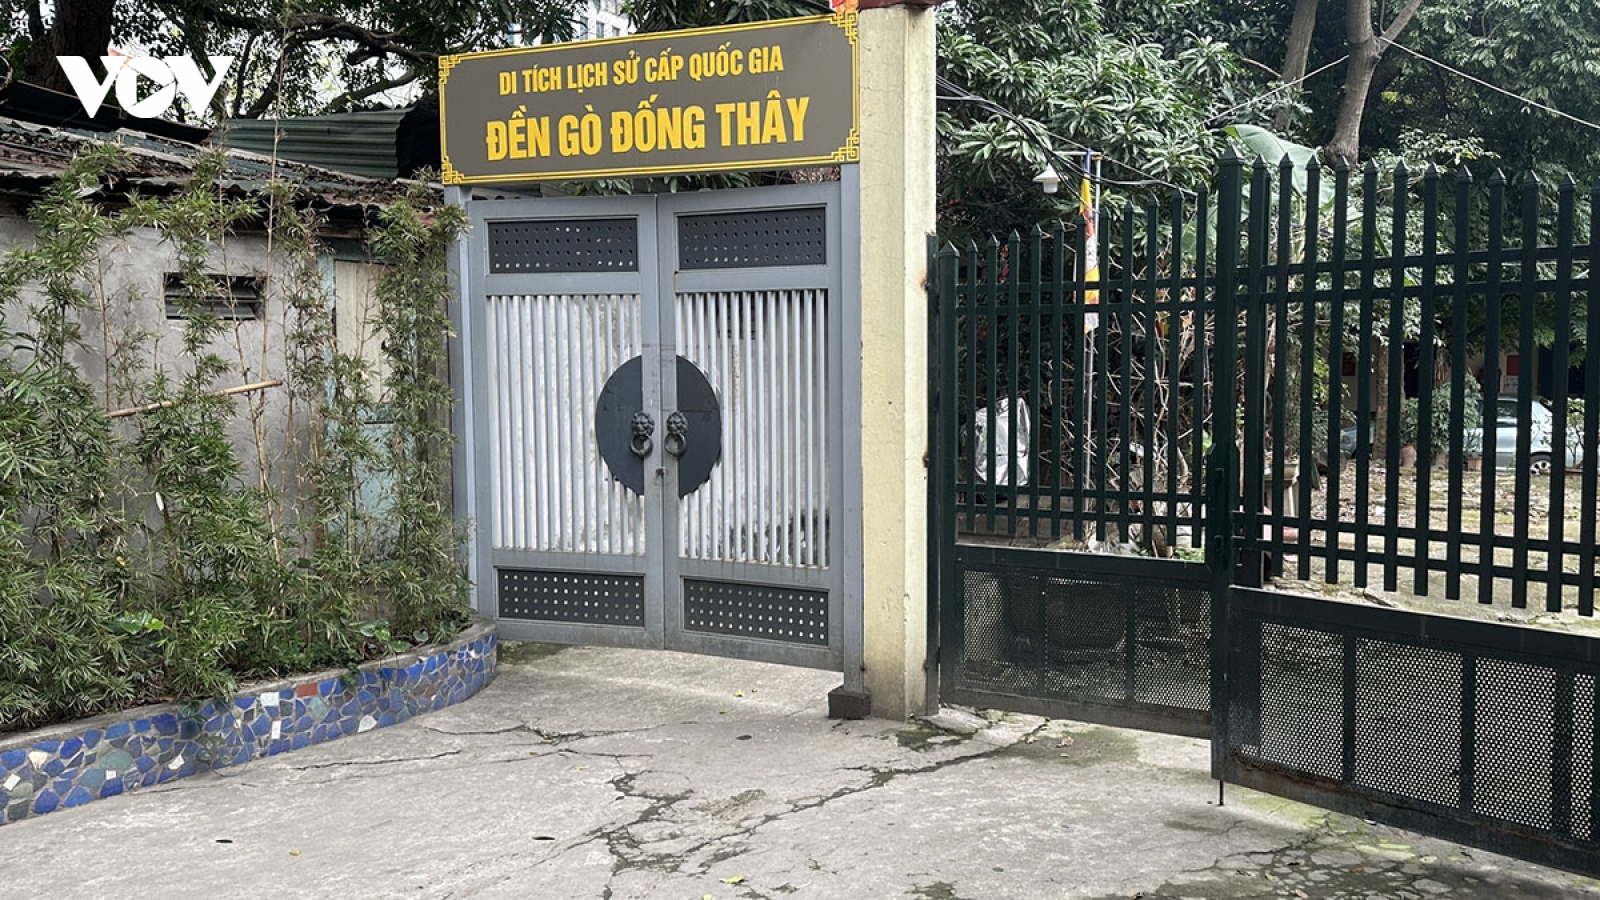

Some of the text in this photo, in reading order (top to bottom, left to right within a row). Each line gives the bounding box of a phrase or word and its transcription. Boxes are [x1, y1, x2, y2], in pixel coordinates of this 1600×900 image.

[499, 42, 784, 96] DI TÍCH LỊCH SỬ CẤP QUỐC GIA
[486, 90, 809, 161] ĐỀN GÒ ĐỐNG THÂY
